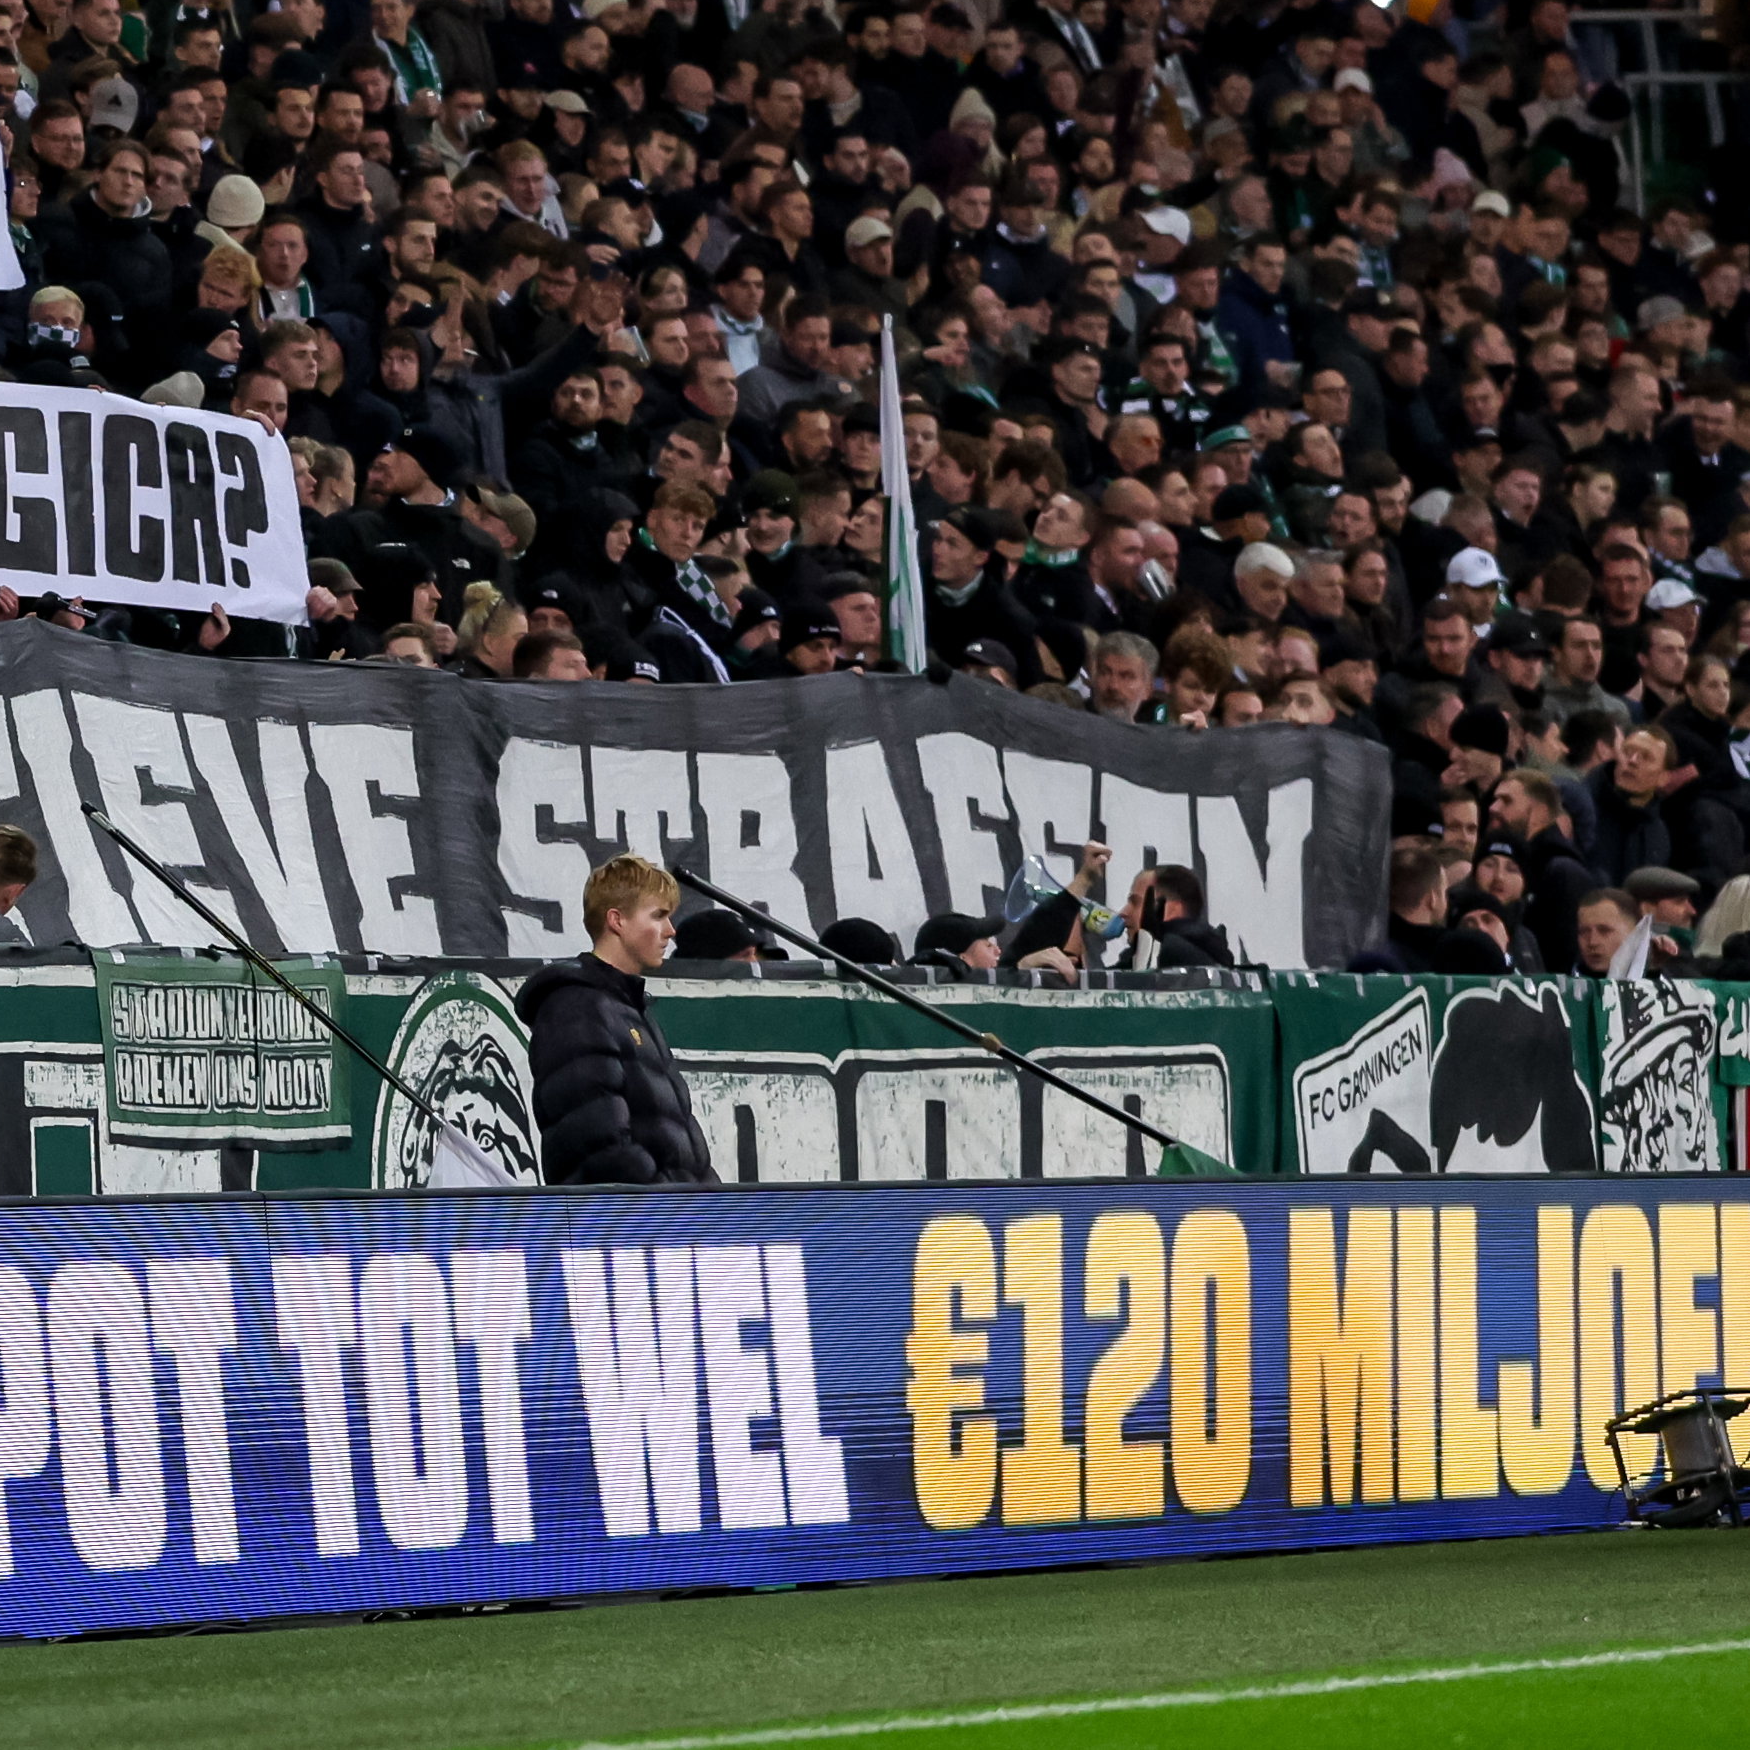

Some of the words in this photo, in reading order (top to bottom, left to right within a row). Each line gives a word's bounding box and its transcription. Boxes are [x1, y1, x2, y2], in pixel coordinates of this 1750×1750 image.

[115, 1050, 210, 1107] BREKEN
[214, 1053, 257, 1108] ONS
[1308, 1086, 1336, 1130] FC
[277, 1250, 537, 1559] TOT
[561, 1242, 851, 1540] WEL
[904, 1208, 1252, 1534] €120
[1286, 1200, 1750, 1510] MILJOE
